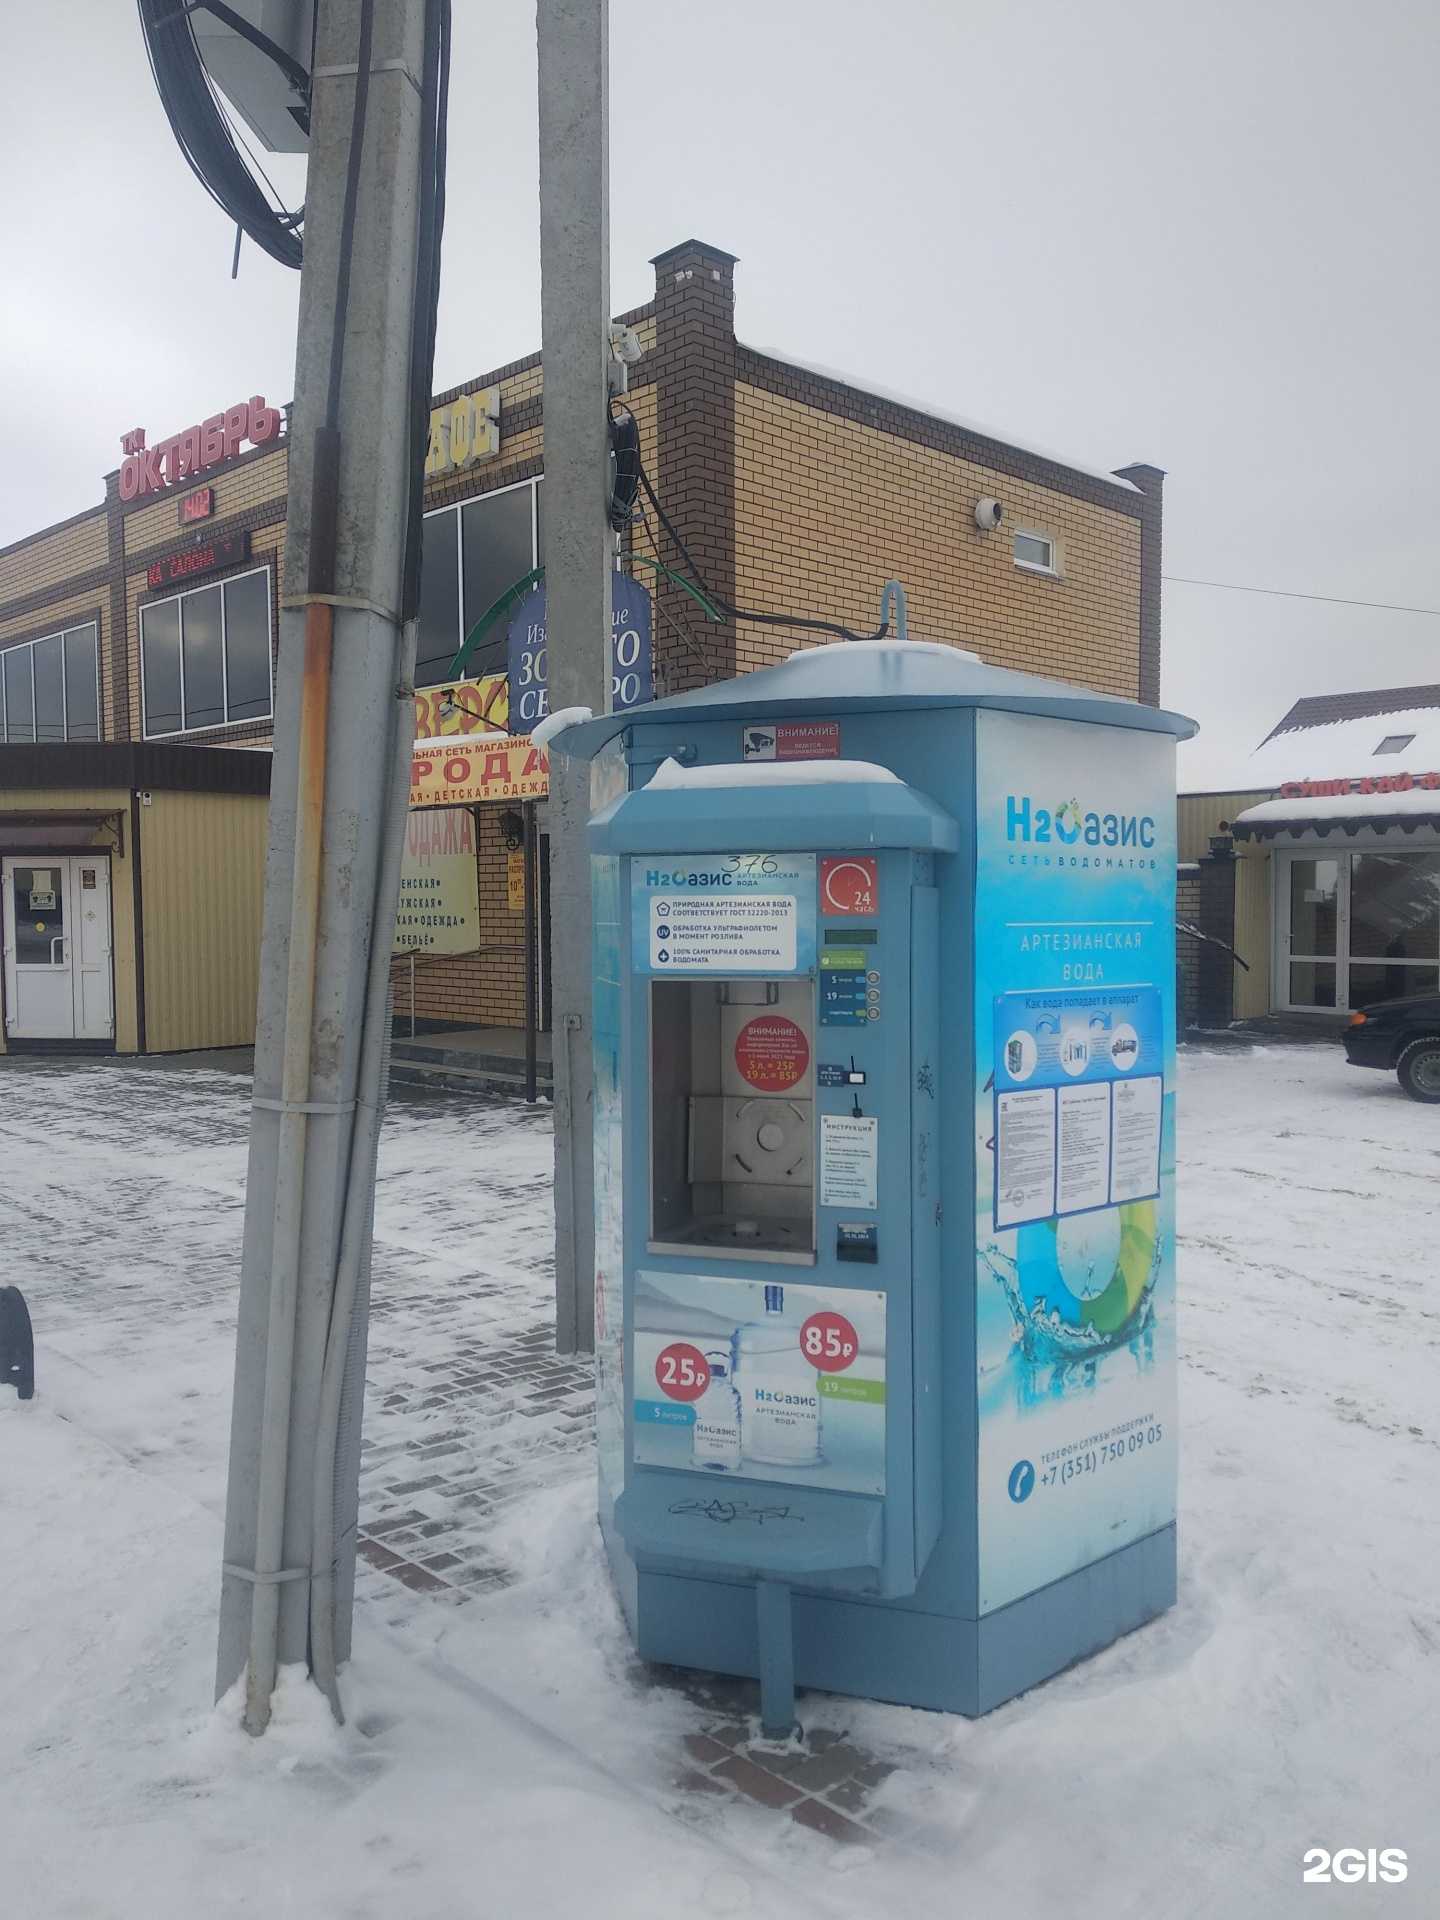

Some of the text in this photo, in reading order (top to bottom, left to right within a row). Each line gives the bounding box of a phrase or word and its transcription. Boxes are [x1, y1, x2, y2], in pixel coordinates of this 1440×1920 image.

[119, 395, 280, 500] ОКТЯБРЬ
[777, 727, 839, 738] ВНИМАНИЕ!
[445, 745, 472, 757] СЕТЬ
[434, 786, 490, 803] ДЕТСКАЯ
[721, 854, 778, 874] 376
[1008, 855, 1157, 869] СЕТЬ ВОДОМАТОВ
[854, 891, 872, 906] 24
[672, 909, 728, 917] СООТВЕТСТВУЕТ
[1020, 932, 1142, 951] АРТЕЗИАНСКАЯ
[1063, 963, 1105, 981] ВОДА
[827, 992, 838, 1001] 19
[826, 1124, 873, 1132] ИНСТРУКЦИЯ
[654, 1407, 661, 1418] 5
[755, 1407, 817, 1420] АРТЕЗИАНСКАЯ
[1041, 1444, 1079, 1464] ТЕЛЕФОН
[1079, 1431, 1110, 1450] СЛУЖБЫ
[1040, 1424, 1162, 1486] +7 (351) 750 09 05
